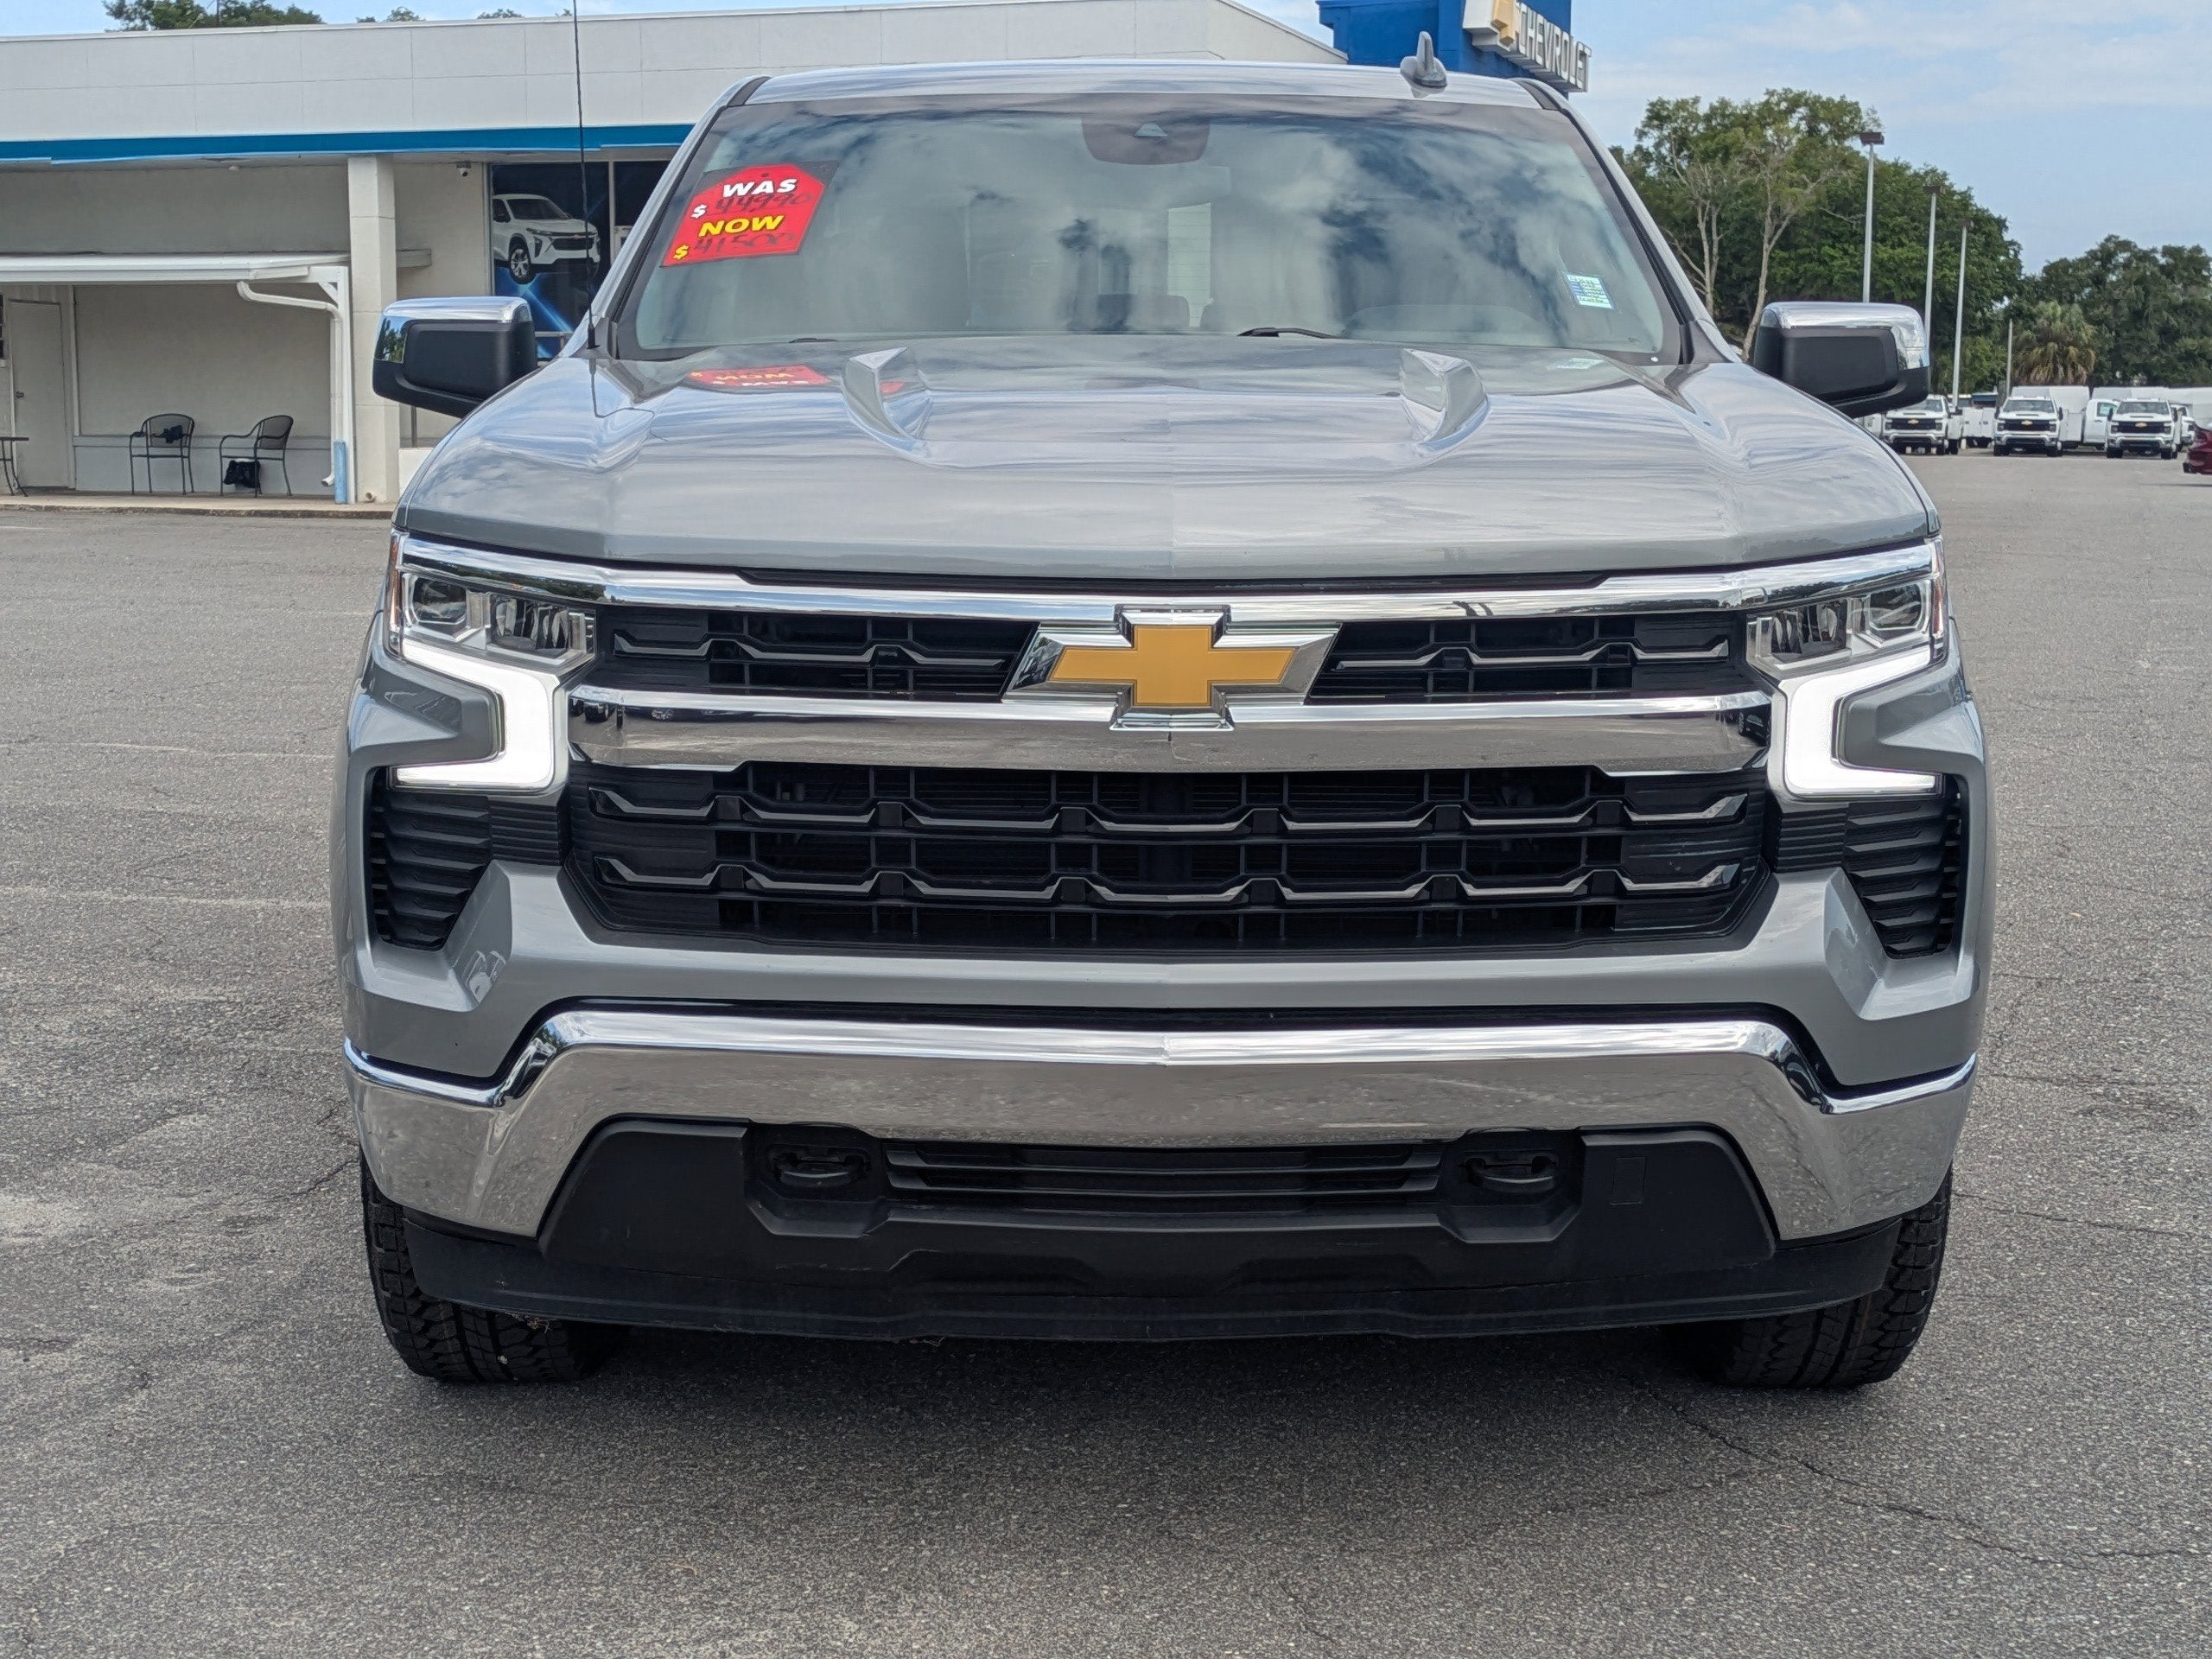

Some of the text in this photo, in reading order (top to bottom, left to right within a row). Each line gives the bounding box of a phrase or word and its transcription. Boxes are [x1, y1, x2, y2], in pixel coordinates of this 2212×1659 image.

[1518, 2, 1592, 92] CHEVROLET
[722, 178, 798, 198] WAS
[698, 214, 785, 238] NOW
